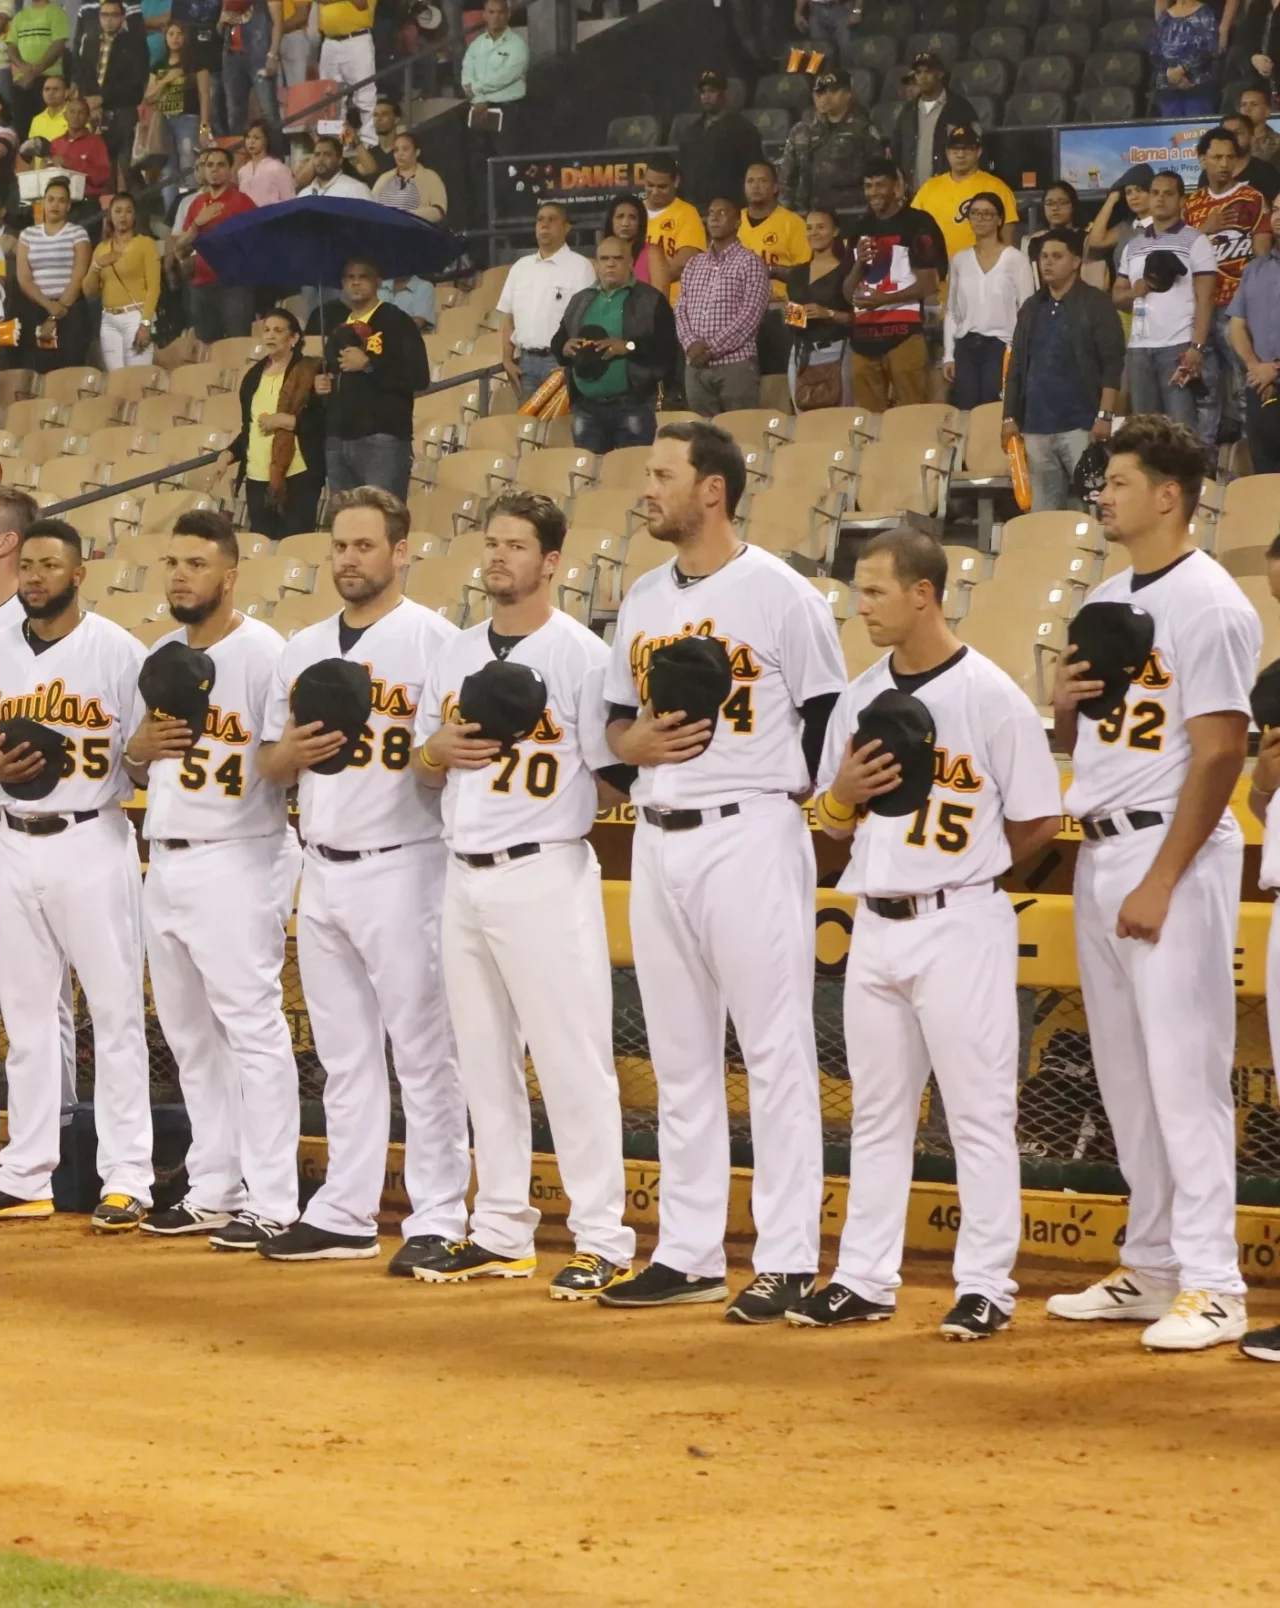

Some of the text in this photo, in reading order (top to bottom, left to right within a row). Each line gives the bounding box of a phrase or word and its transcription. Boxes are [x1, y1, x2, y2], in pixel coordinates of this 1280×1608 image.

[561, 164, 628, 189] DAME
[1130, 147, 1168, 163] llama
[1170, 148, 1179, 160] a
[720, 684, 754, 735] 4
[346, 722, 414, 771] 68
[179, 746, 247, 798] 54
[491, 745, 560, 799] 70
[904, 797, 975, 856] 15
[1023, 1212, 1082, 1246] laro
